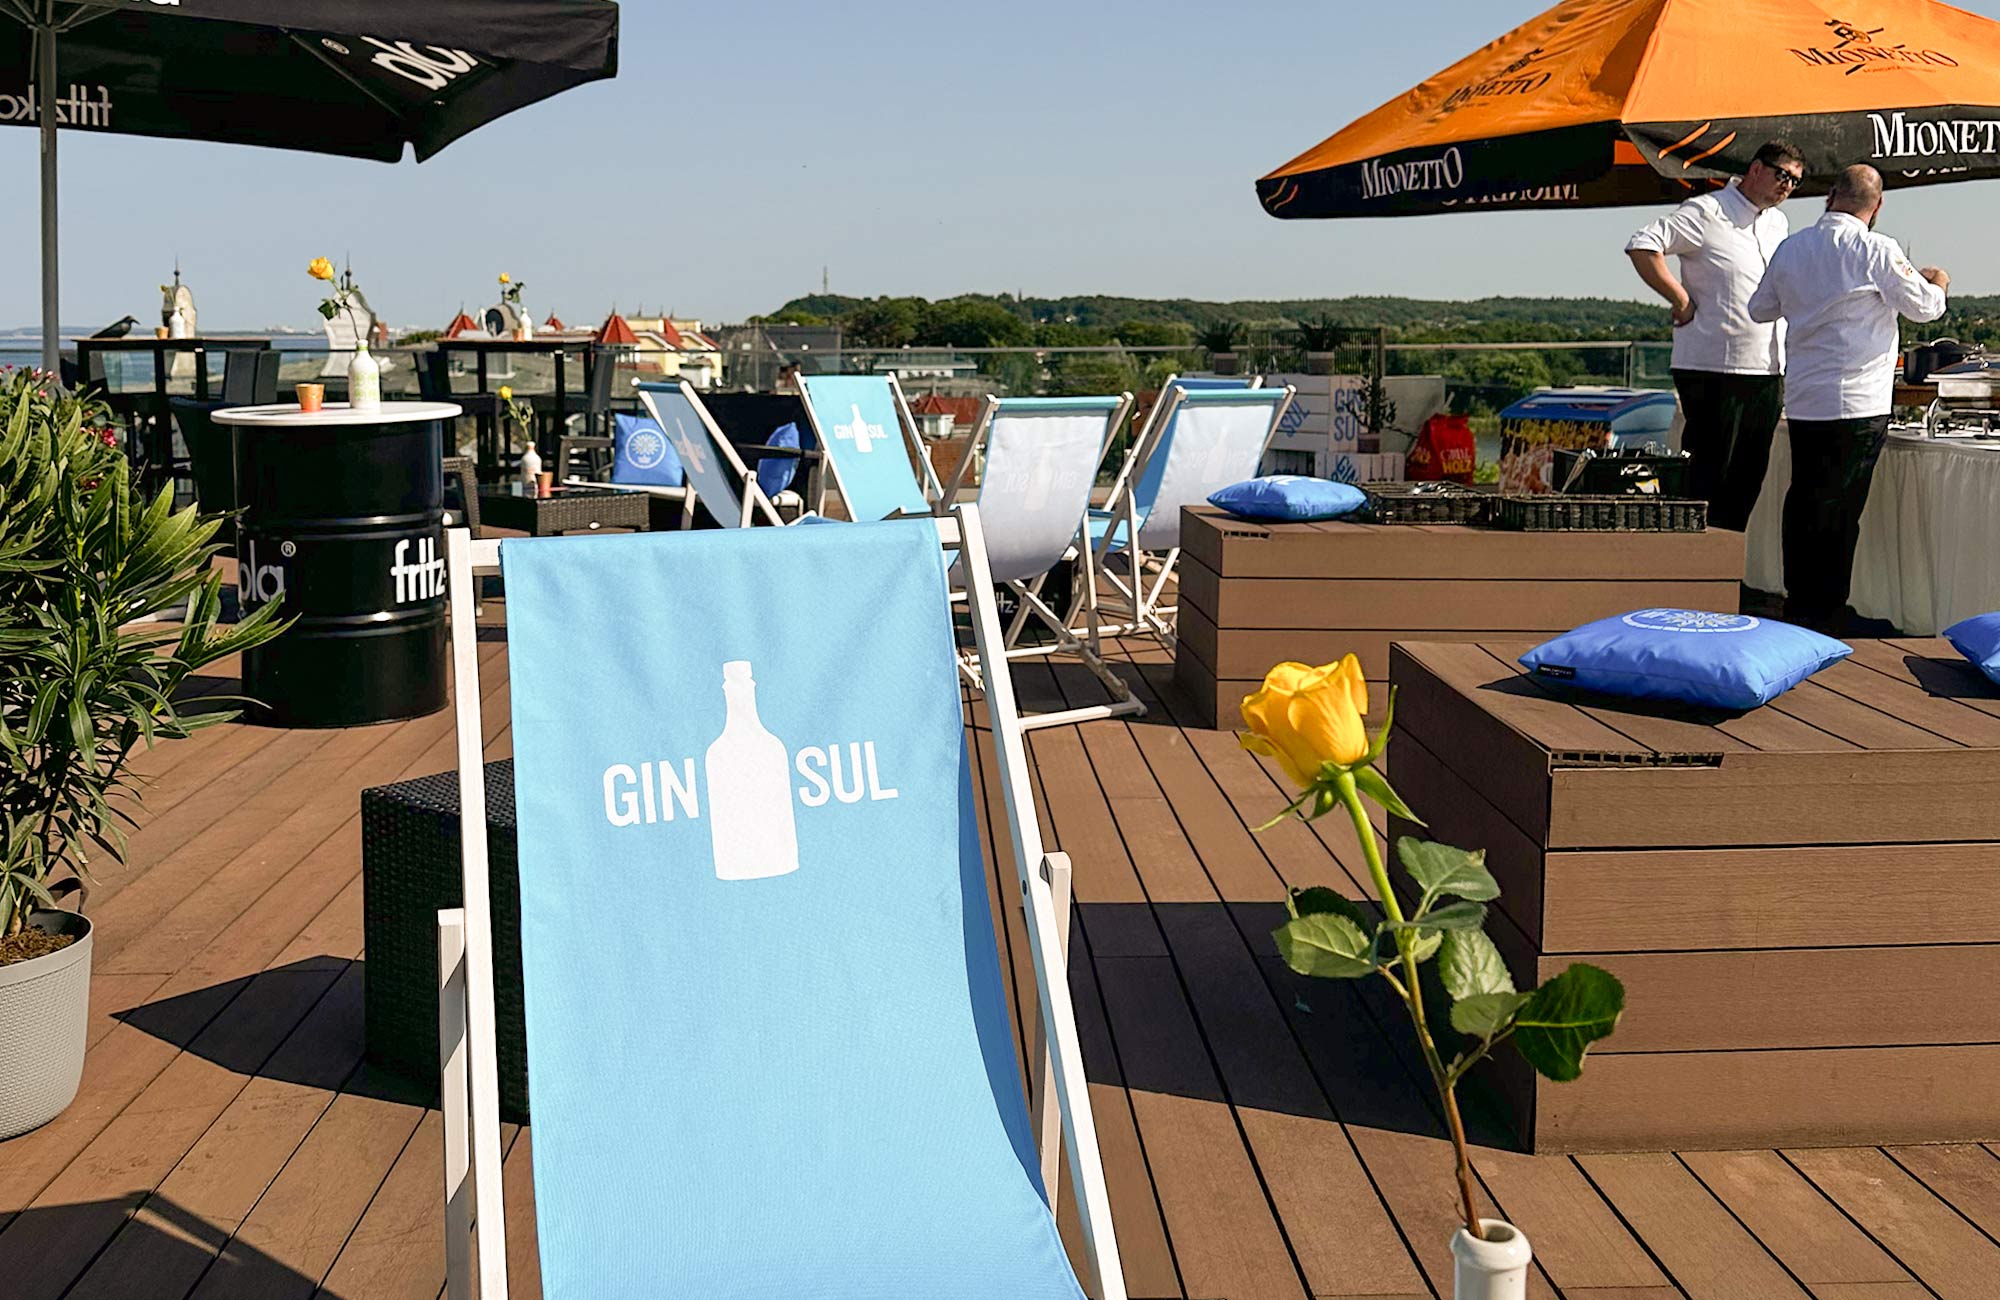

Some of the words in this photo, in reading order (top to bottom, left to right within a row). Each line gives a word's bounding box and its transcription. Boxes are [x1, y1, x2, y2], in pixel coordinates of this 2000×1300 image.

[1360, 146, 1464, 199] MIONETTO
[602, 757, 700, 827] GIN
[795, 740, 899, 807] SUL
